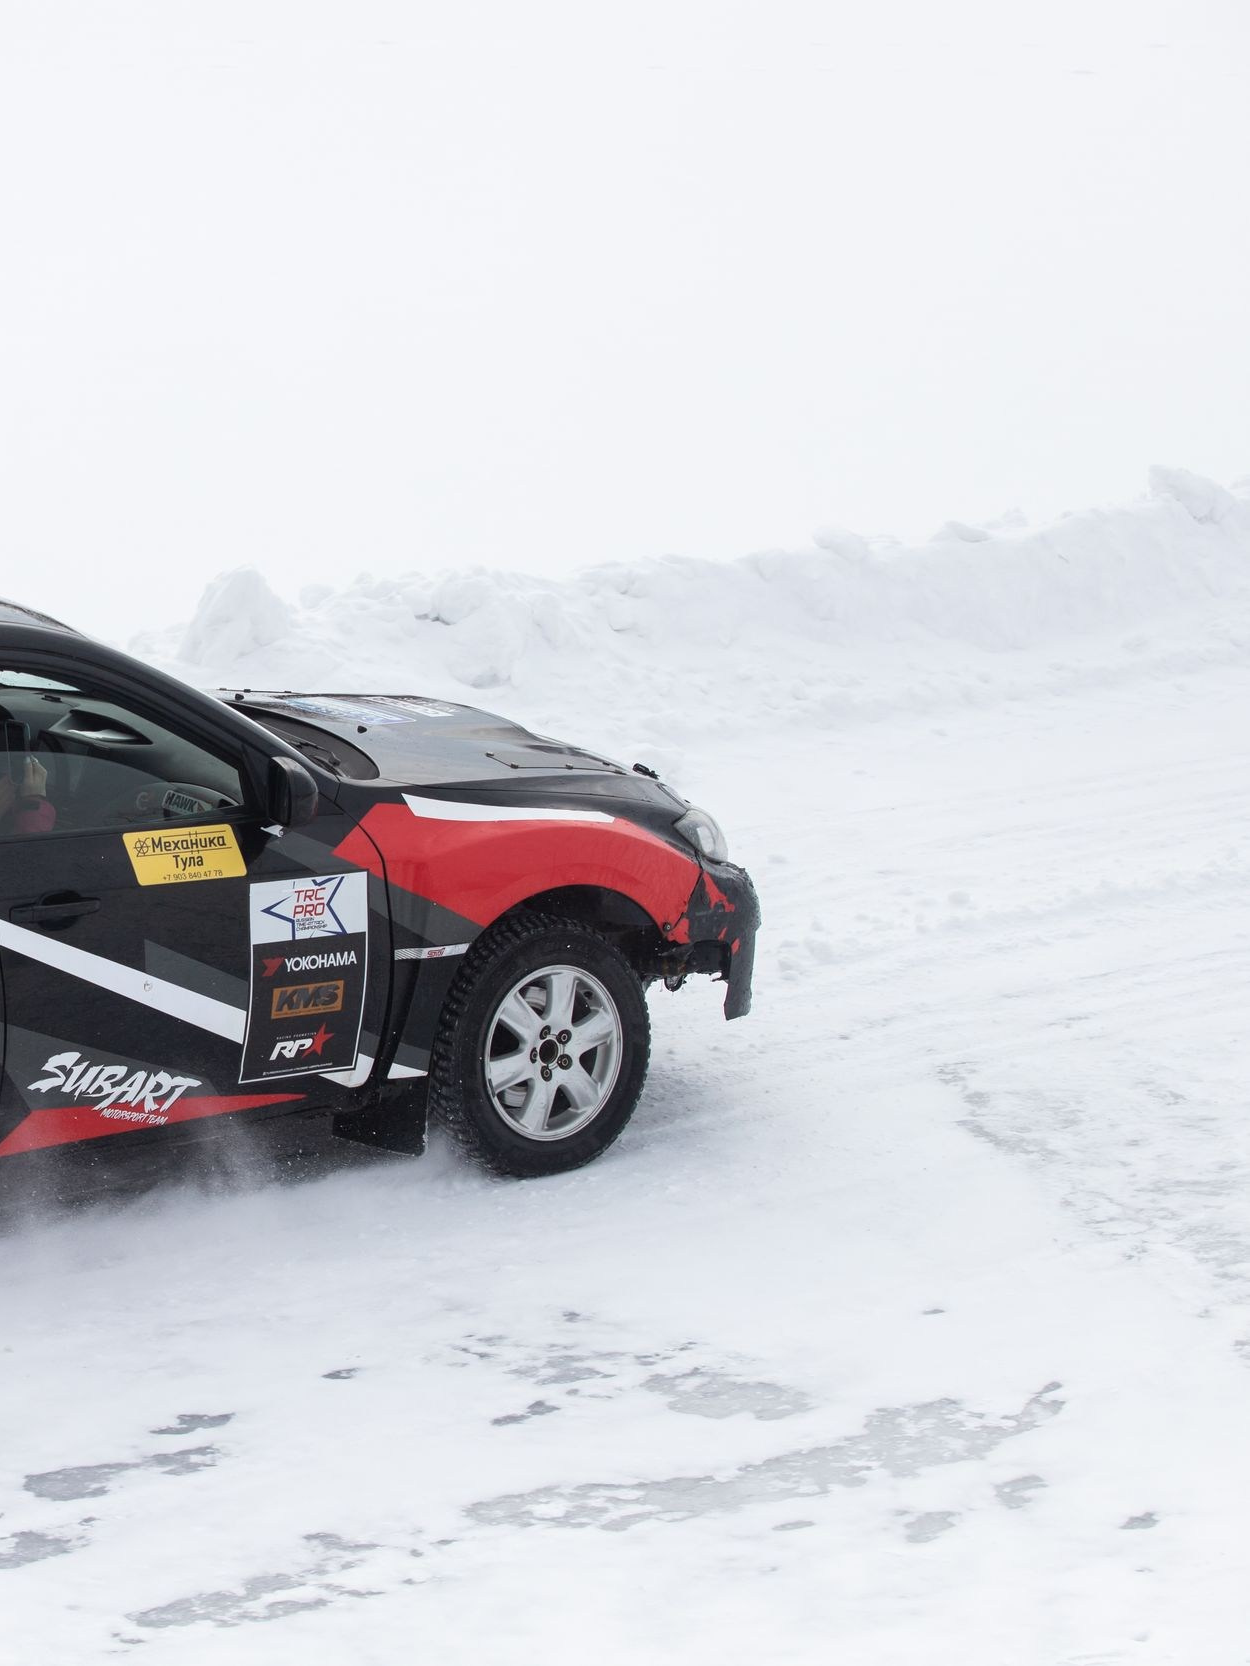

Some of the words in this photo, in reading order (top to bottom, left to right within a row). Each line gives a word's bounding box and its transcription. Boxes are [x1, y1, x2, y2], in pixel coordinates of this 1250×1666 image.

[151, 834, 227, 853] Механика
[172, 854, 204, 871] Тула
[173, 873, 187, 881] 903
[189, 871, 201, 879] 840
[213, 869, 223, 877] 78
[294, 887, 326, 903] TRC
[293, 903, 325, 918] PRO
[284, 950, 358, 973] YOKOHAMA
[275, 983, 340, 1012] KMS
[269, 1038, 313, 1061] RP
[27, 1051, 203, 1114] SUBART
[100, 1107, 151, 1124] MOTORSPORT
[148, 1113, 169, 1126] TEAM
